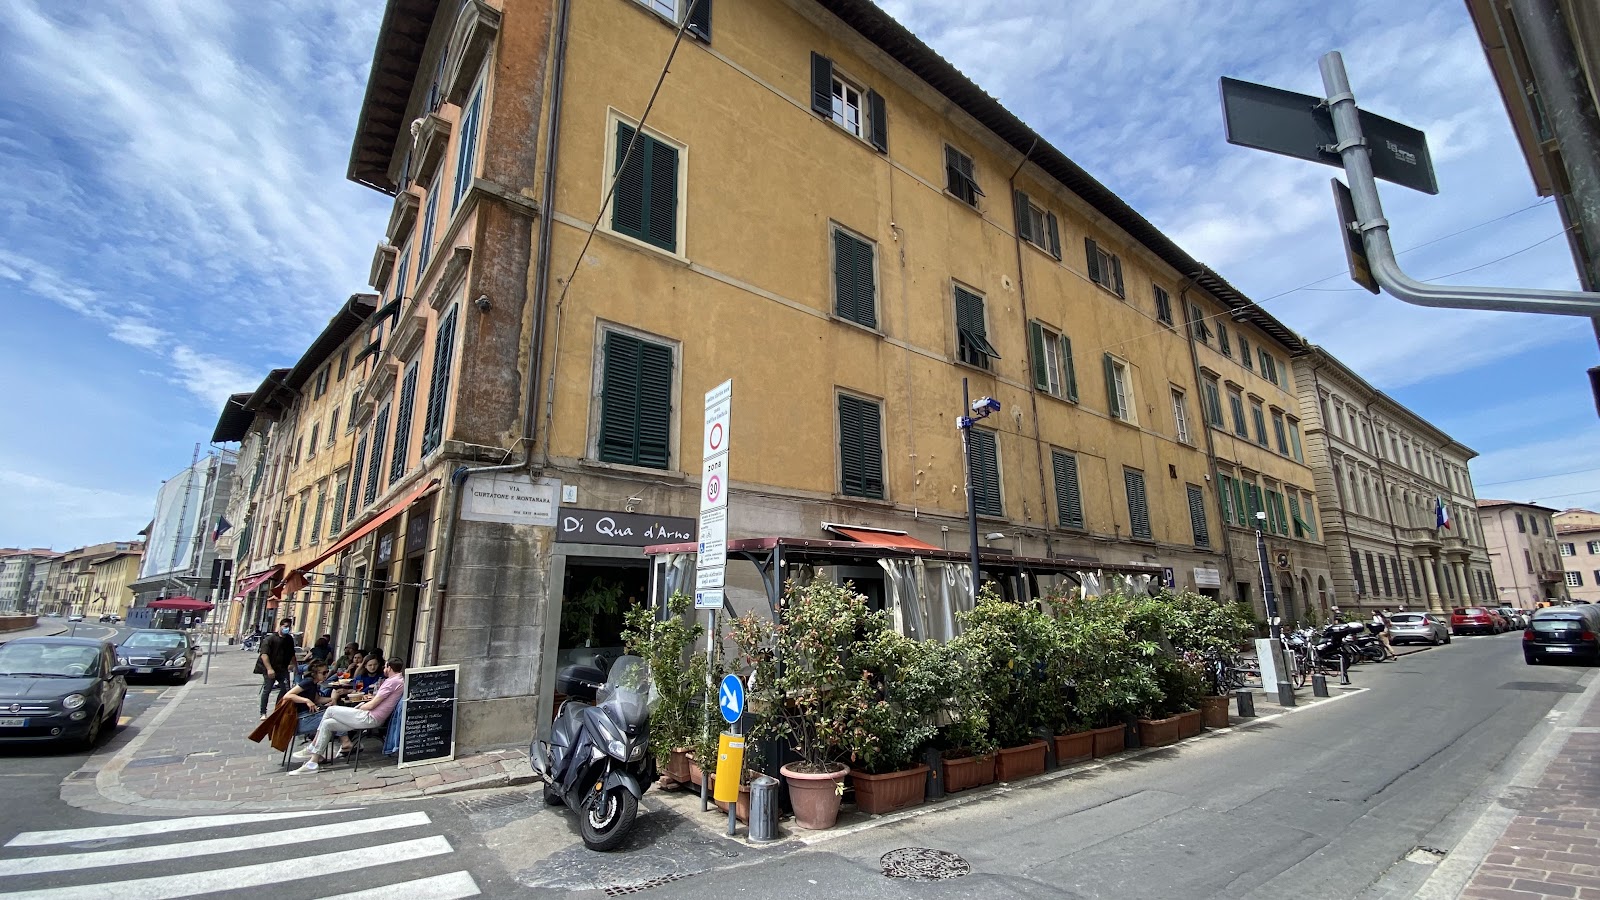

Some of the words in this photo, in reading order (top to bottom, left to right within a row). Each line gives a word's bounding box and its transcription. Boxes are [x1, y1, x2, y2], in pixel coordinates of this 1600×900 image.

[708, 461, 721, 472] zona
[710, 482, 717, 495] 30
[474, 491, 509, 500] CURTATONE
[516, 496, 551, 504] MONTANARA
[563, 516, 584, 533] Di
[595, 517, 634, 537] Qua
[644, 522, 690, 540] d'Arno
